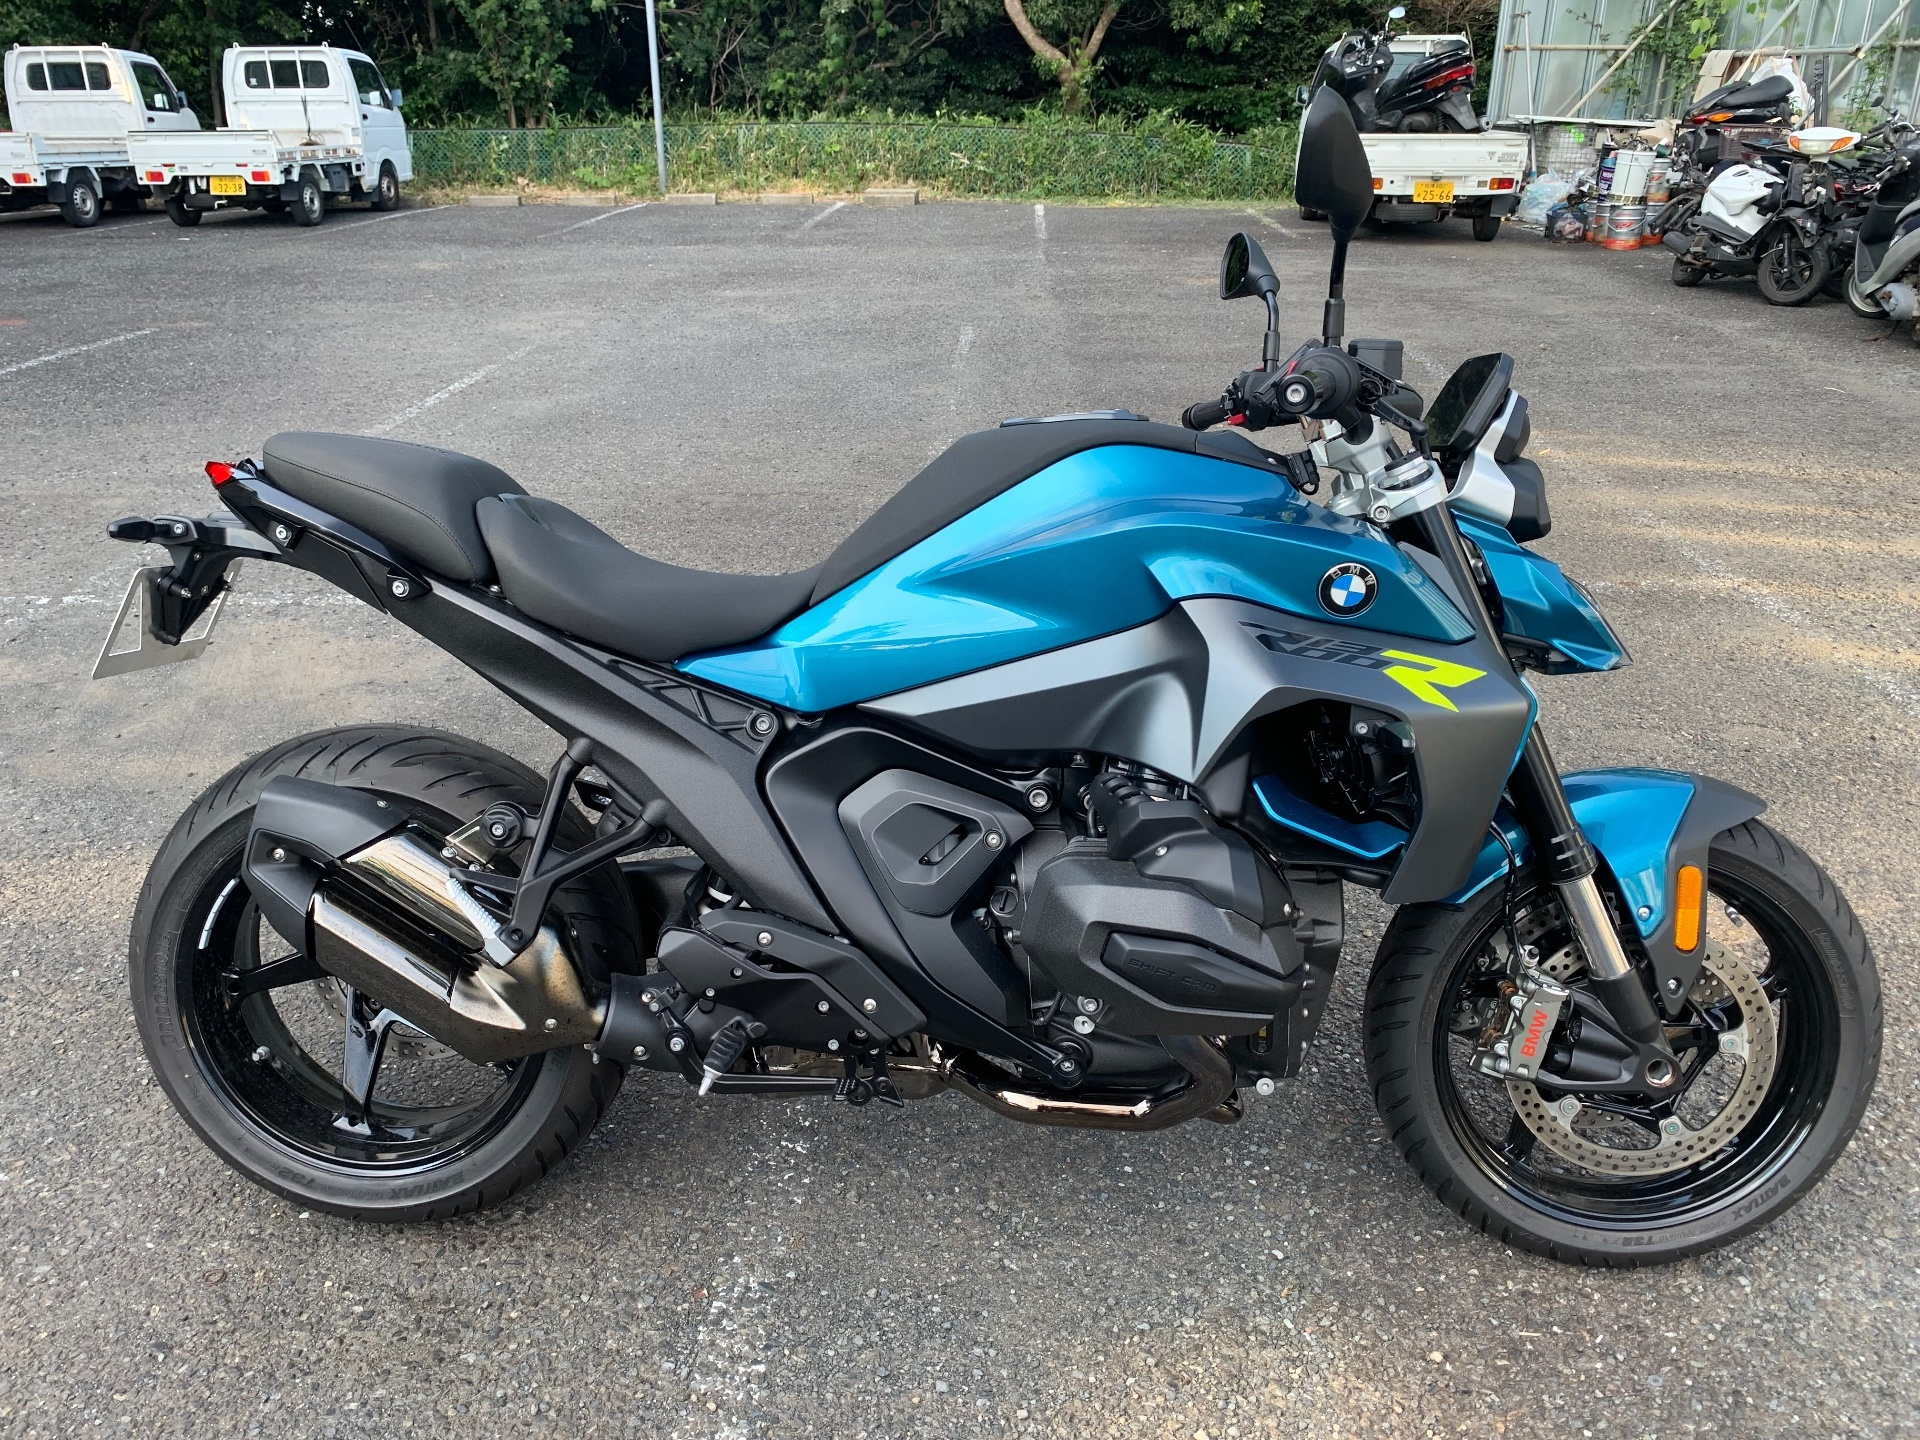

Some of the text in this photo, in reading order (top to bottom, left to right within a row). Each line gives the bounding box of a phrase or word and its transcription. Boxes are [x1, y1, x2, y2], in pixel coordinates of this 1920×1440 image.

[218, 183, 243, 193] 32-38
[1422, 190, 1451, 201] 25-66
[1329, 565, 1375, 586] BMW
[1128, 957, 1217, 993] SHIFT CAM
[1520, 1009, 1548, 1057] BMW
[389, 1169, 465, 1200] BATTLAX
[1732, 1173, 1792, 1222] BATTLAX
